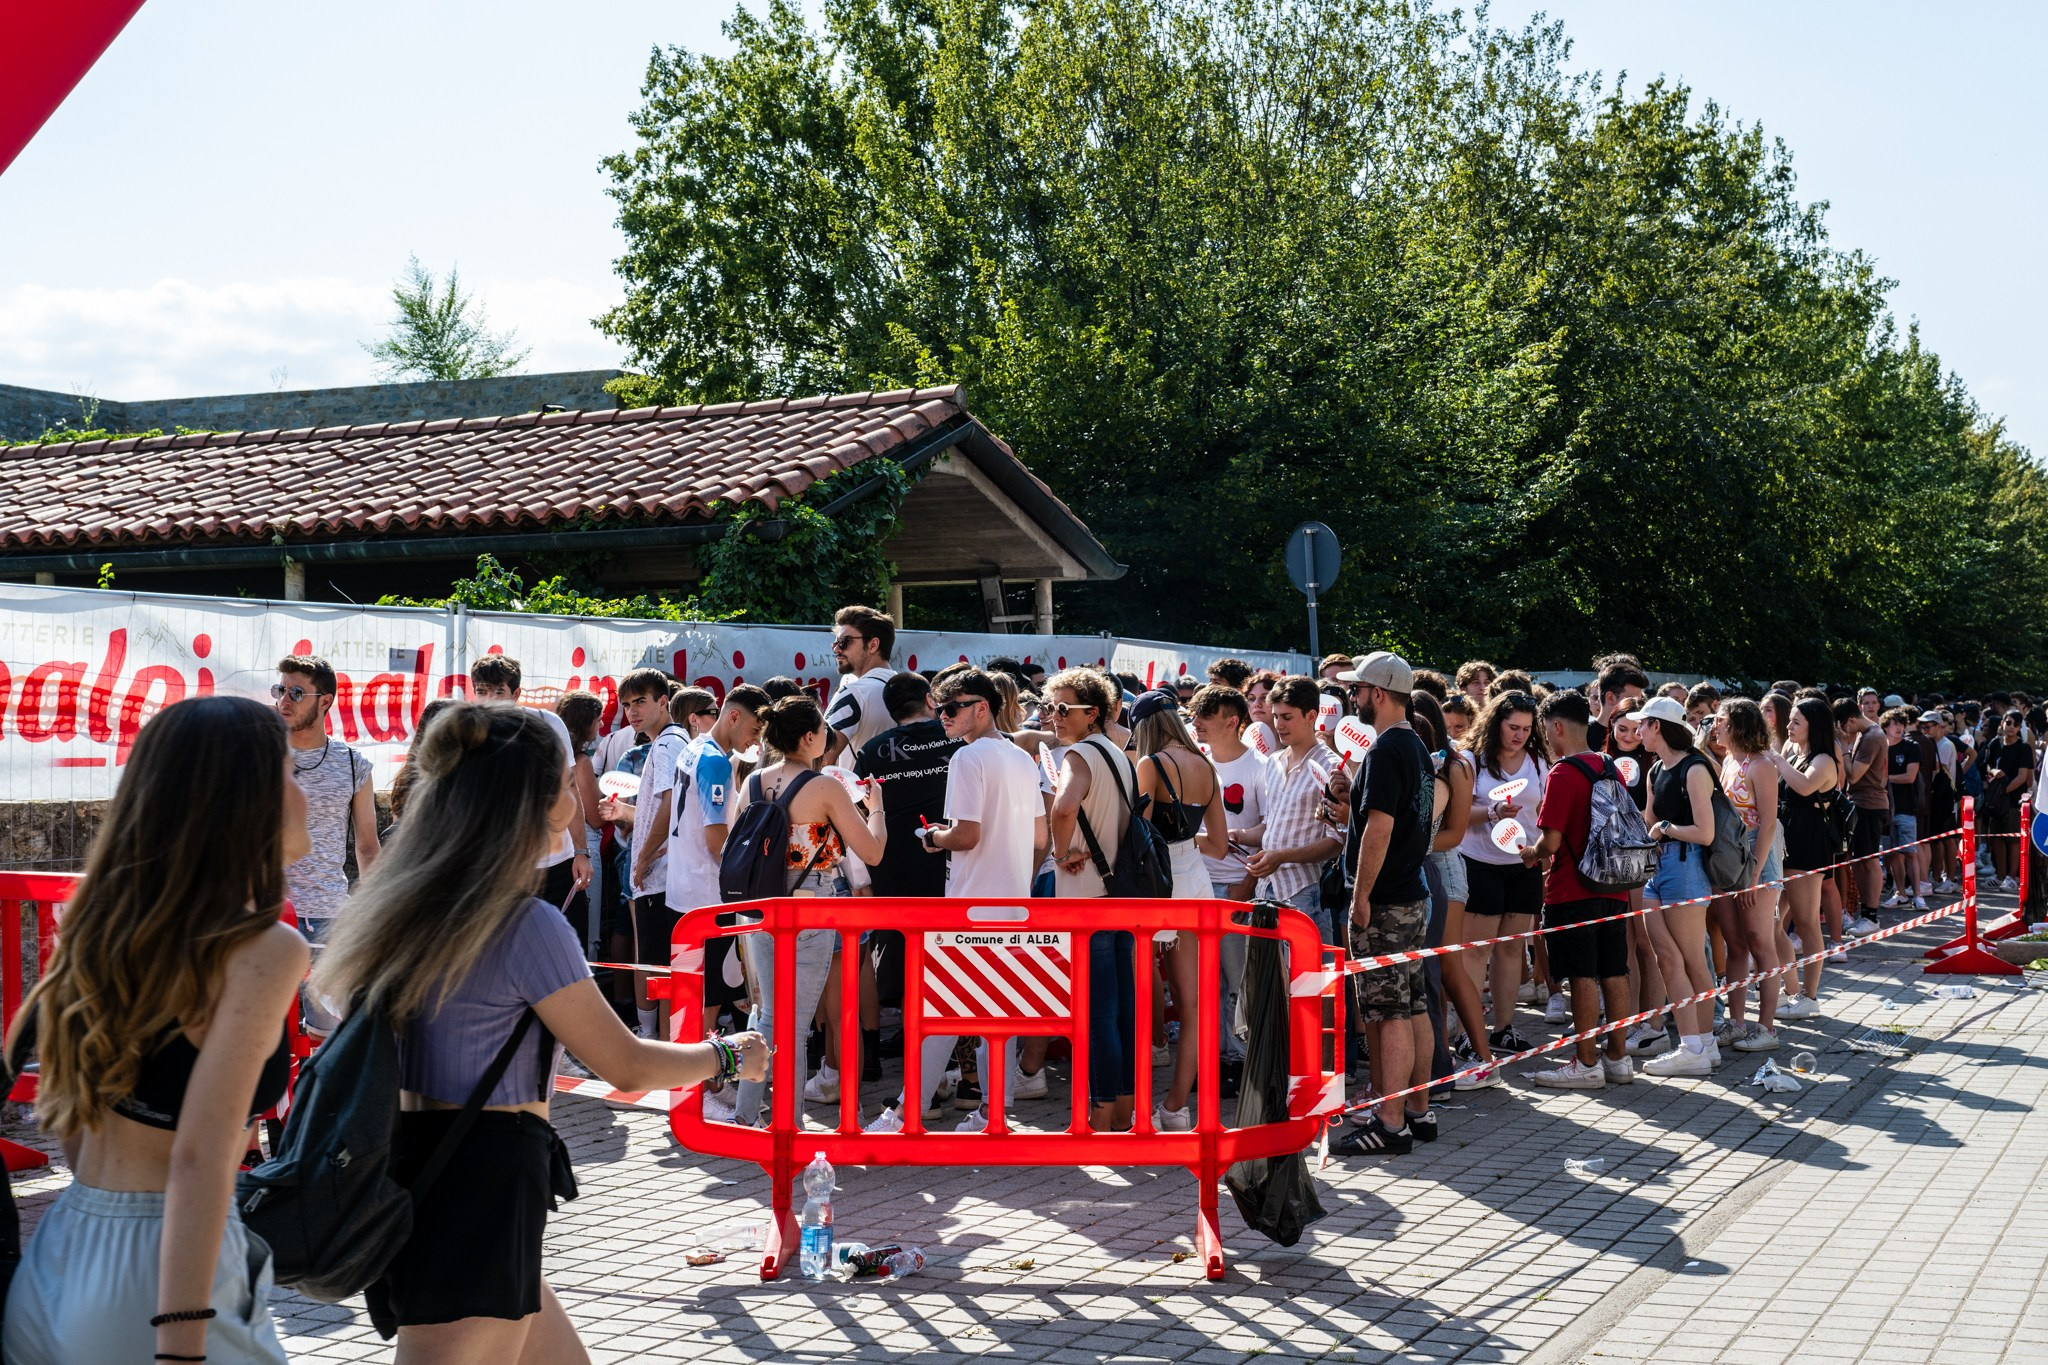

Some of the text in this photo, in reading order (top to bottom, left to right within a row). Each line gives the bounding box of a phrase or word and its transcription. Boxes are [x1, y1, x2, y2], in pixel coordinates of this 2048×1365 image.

[321, 640, 407, 659] LATTERIE
[591, 648, 666, 664] LATTERIE
[811, 653, 838, 667] LATT
[0, 628, 215, 767] alpi
[1341, 722, 1371, 749] inalp
[902, 743, 928, 752] Calvin
[928, 740, 948, 749] Klein
[903, 769, 923, 778] Klein
[924, 765, 949, 775] Calvin
[1496, 822, 1519, 846] inalpi
[955, 934, 1060, 944] Comune di ALBA
